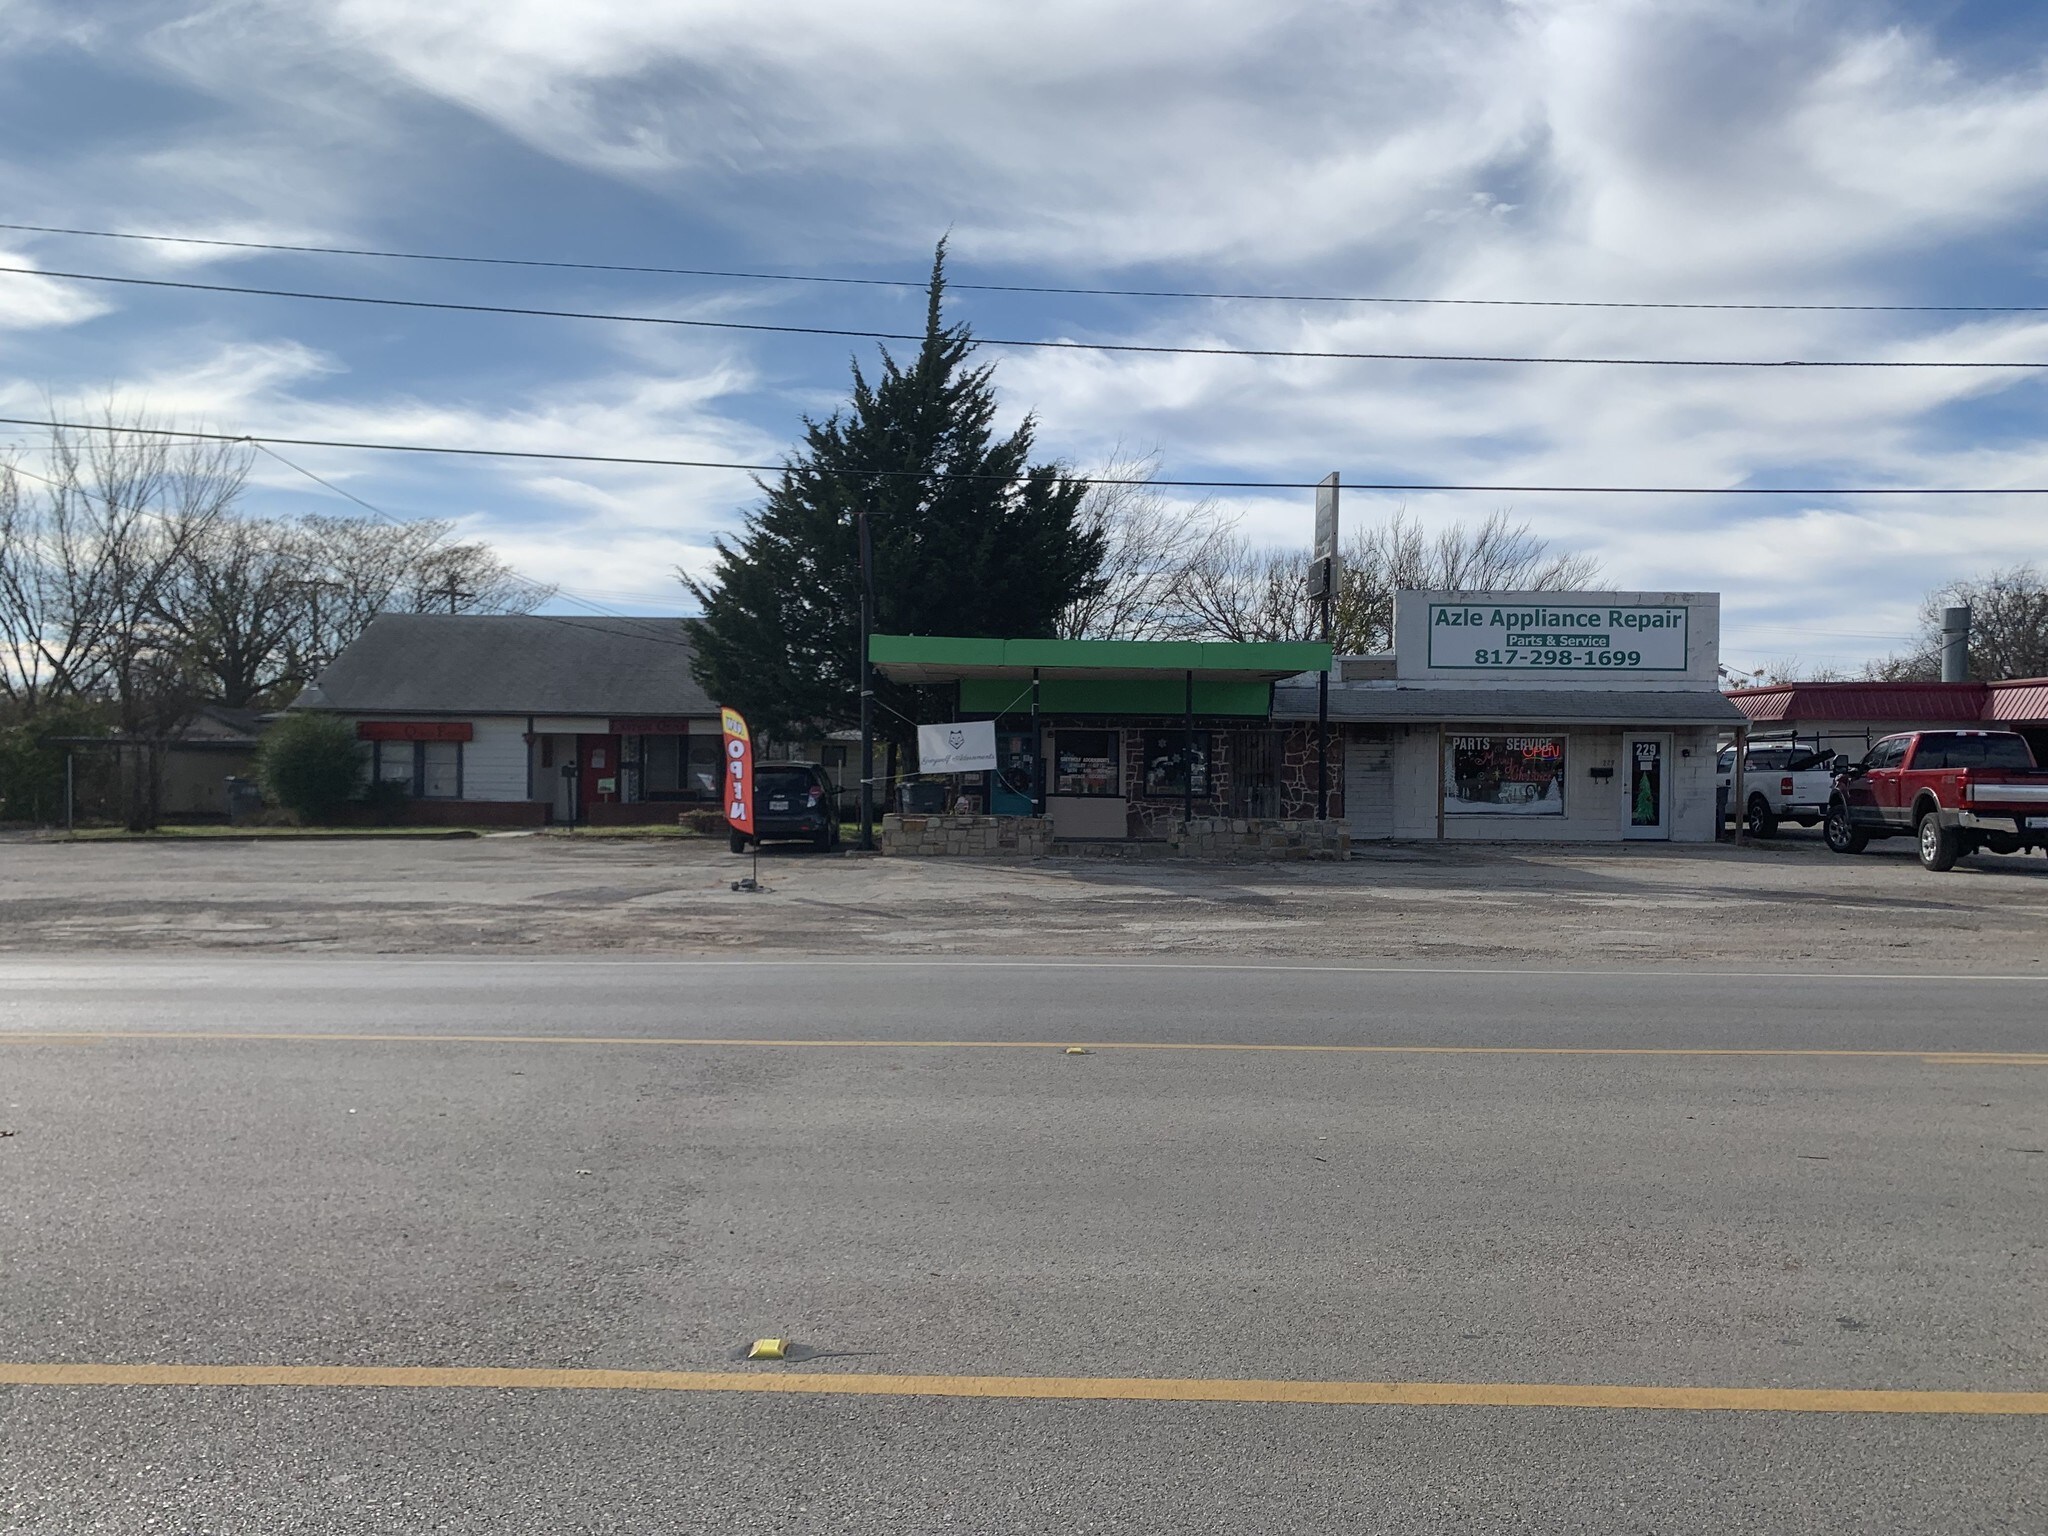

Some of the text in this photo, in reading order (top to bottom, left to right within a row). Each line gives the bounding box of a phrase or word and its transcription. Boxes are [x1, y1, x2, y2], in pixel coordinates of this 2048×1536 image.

[1434, 608, 1682, 632] Azle Appliance Repair
[1508, 635, 1608, 648] Parts & Service
[1474, 649, 1642, 667] 817-298-1699
[1452, 737, 1552, 751] PARTS SERVICE
[1636, 743, 1657, 756] 229
[1522, 745, 1560, 758] OPEN
